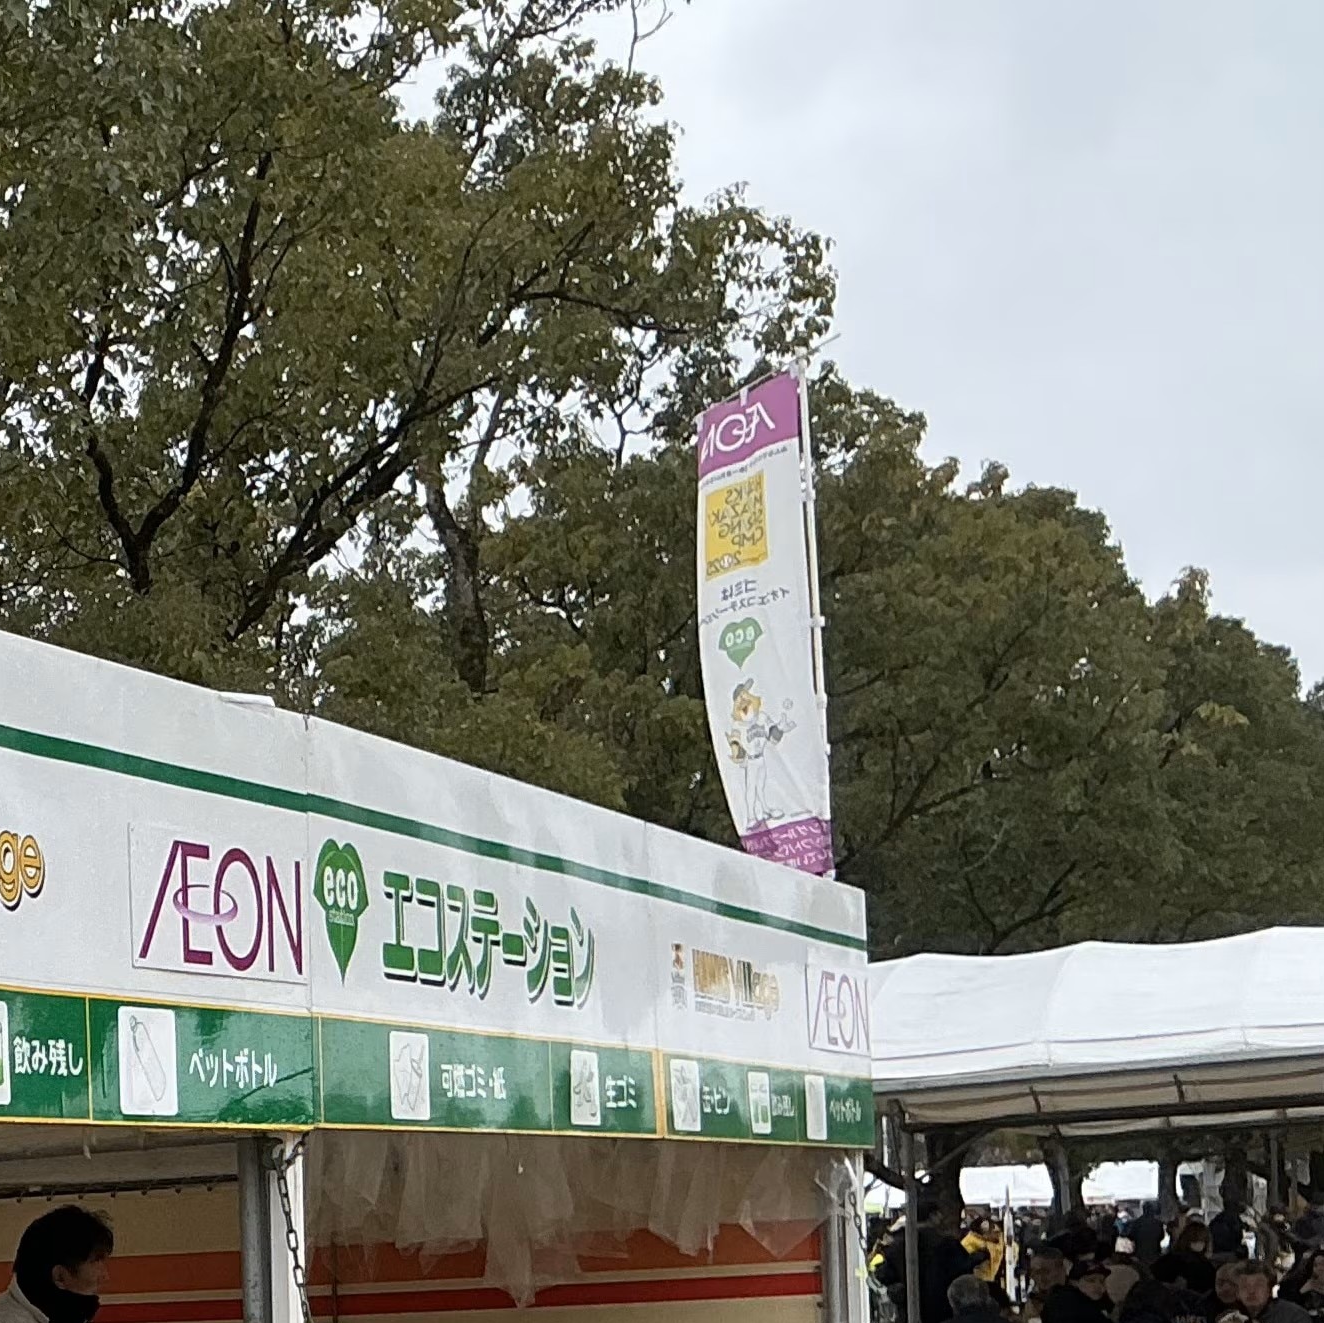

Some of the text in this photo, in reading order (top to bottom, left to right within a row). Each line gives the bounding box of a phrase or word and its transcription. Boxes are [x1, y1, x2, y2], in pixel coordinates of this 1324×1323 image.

[323, 866, 358, 910] eco
[382, 870, 596, 1010] エコステーション
[13, 1036, 84, 1077] 飲み残し
[605, 1075, 638, 1108] 生ゴミ
